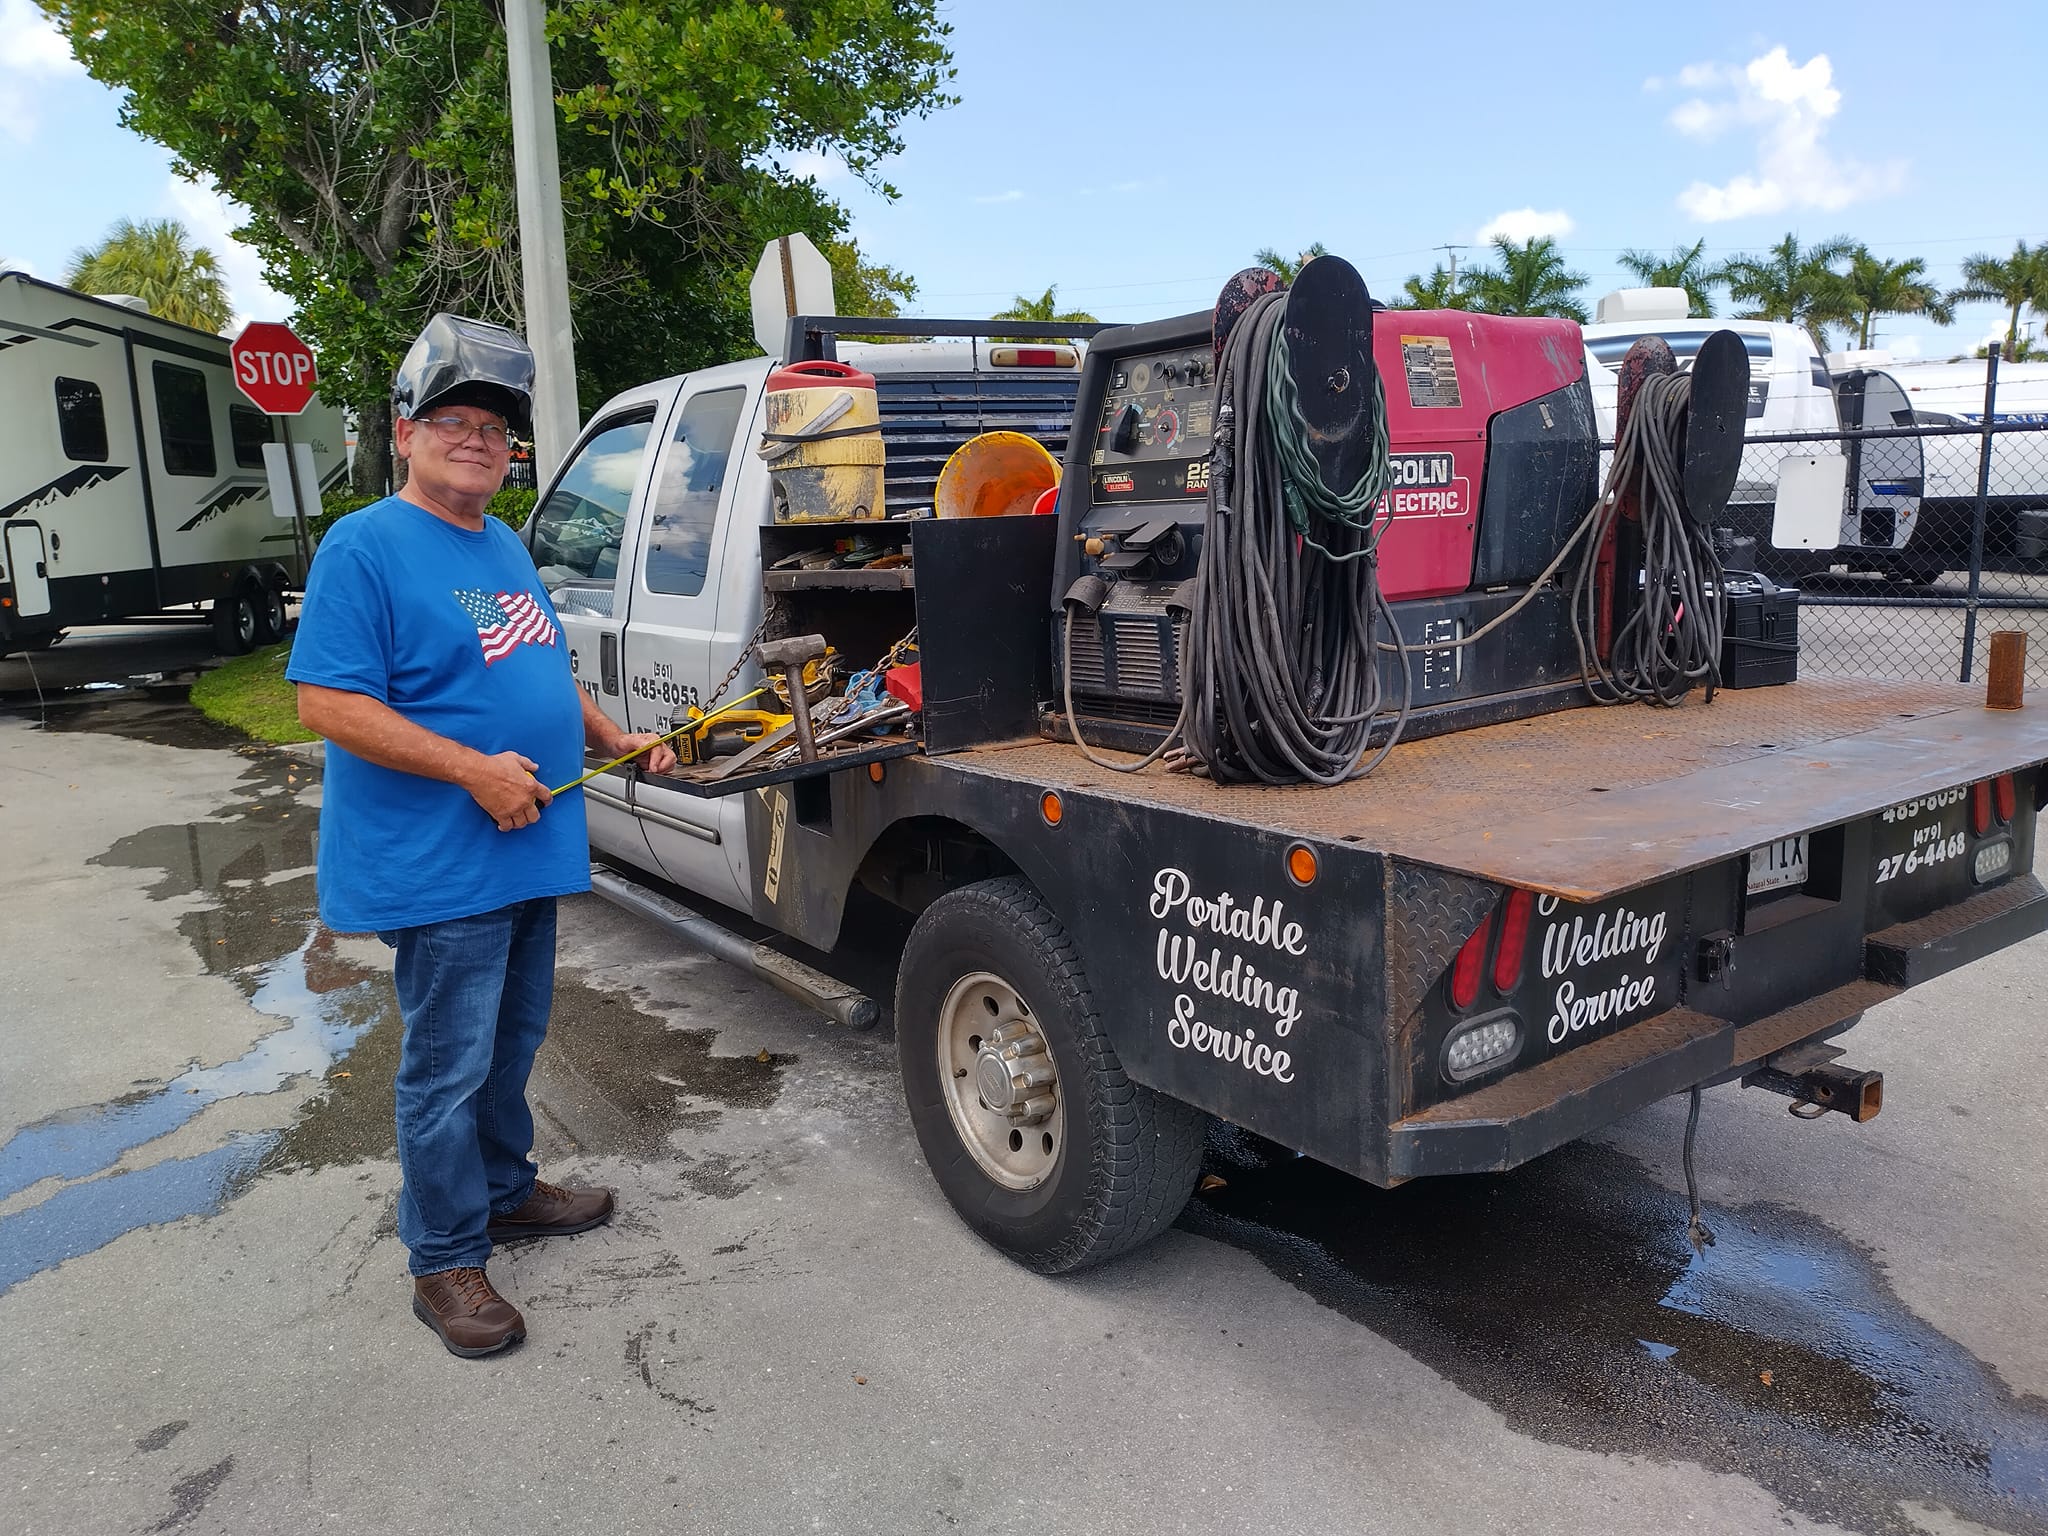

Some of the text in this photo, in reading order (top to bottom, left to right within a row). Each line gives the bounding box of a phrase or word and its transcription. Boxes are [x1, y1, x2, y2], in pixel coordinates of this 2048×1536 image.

[238, 350, 311, 386] STOP
[1104, 475, 1128, 485] LINCOLN
[1186, 480, 1208, 490] RAN
[1187, 462, 1210, 480] 22
[1389, 459, 1448, 486] COLN
[652, 660, 673, 681] (561)
[631, 674, 700, 708] 485-8053
[1913, 820, 1942, 849] (479)
[1875, 831, 1966, 885] 276-4468
[1149, 867, 1308, 956] Portable
[1541, 907, 1668, 979] Welding
[1156, 927, 1303, 1037] Welding
[1547, 974, 1656, 1044] Service
[1167, 993, 1296, 1084] Service
